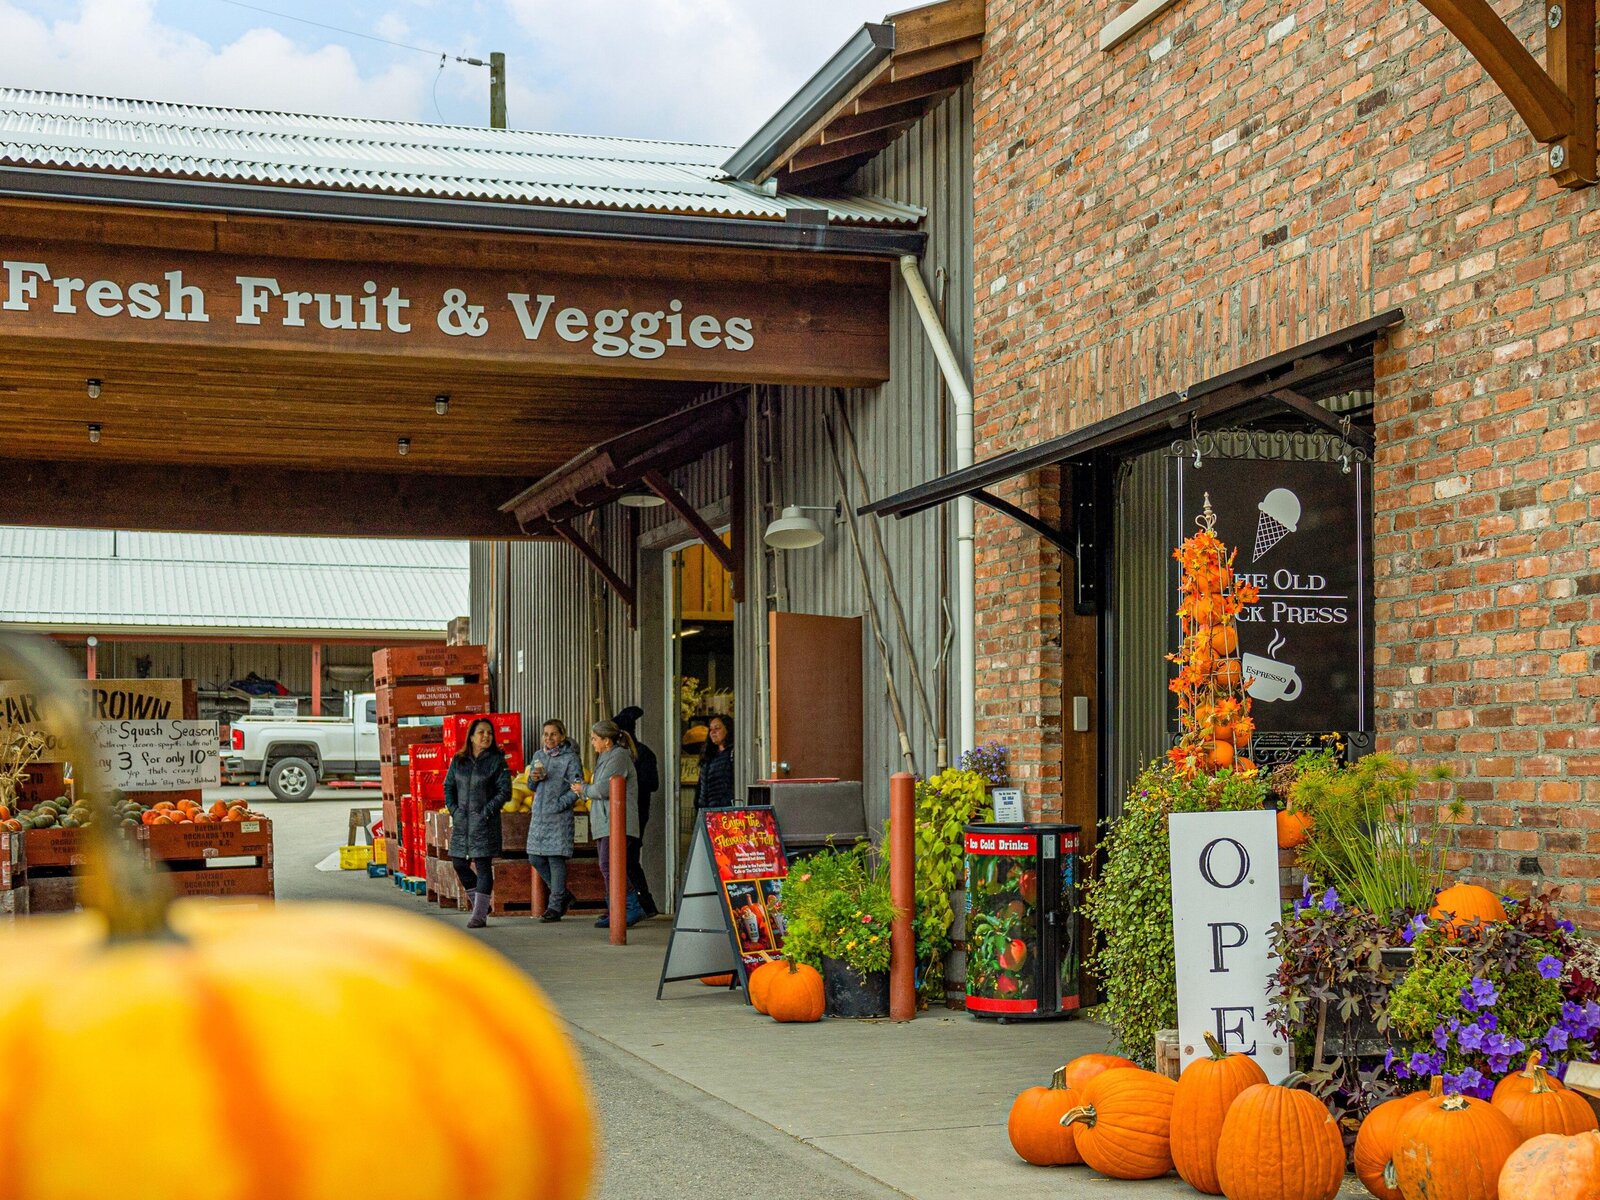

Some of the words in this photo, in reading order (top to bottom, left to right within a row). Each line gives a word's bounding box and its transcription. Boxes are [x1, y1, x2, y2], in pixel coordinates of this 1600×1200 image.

[3, 261, 209, 322] Fresh
[235, 275, 412, 333] Fruit
[437, 288, 489, 337] &
[507, 292, 754, 359] Veggies
[1233, 573, 1268, 590] HE
[1273, 568, 1327, 591] OLD
[1271, 601, 1348, 624] PRESS
[1245, 665, 1287, 684] ESPRESSO
[118, 720, 163, 743] Squash
[168, 720, 220, 741] Season!
[117, 751, 133, 770] 3
[141, 751, 161, 767] for
[165, 751, 185, 768] only
[980, 839, 995, 850] Cold
[998, 839, 1029, 851] Drinks
[1198, 837, 1257, 1057] OPE
